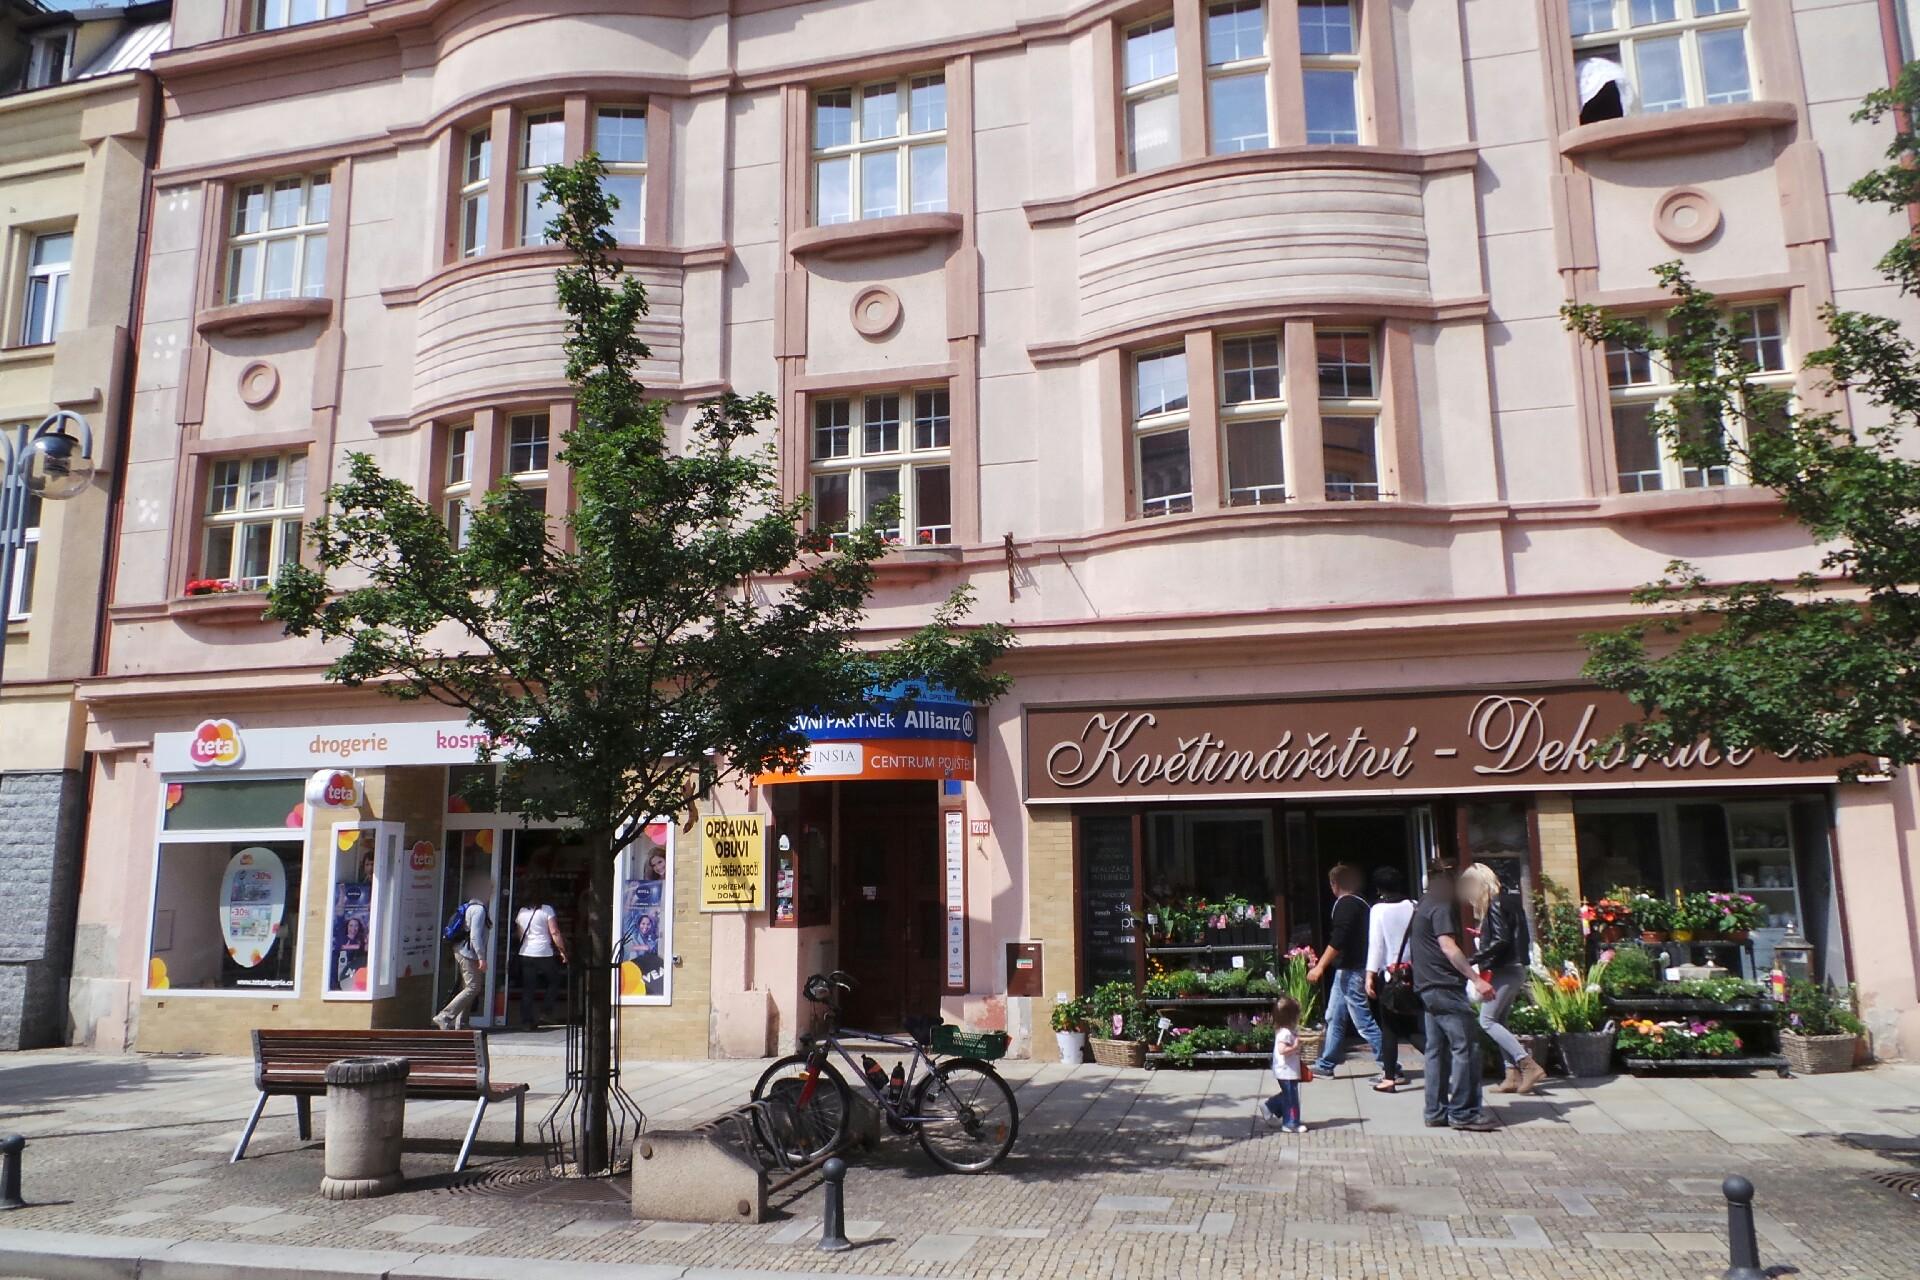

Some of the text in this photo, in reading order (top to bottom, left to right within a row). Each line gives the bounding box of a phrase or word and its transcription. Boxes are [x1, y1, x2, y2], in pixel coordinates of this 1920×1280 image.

[826, 712, 896, 729] PARTNER
[904, 710, 960, 731] Allianz
[195, 736, 234, 756] teta
[309, 732, 389, 757] drogerie
[1047, 712, 1418, 786] Květinářství
[871, 755, 935, 769] CENTRUM
[327, 784, 354, 800] teta
[705, 819, 759, 838] OPRAVNA
[715, 840, 749, 858] OBUVI
[705, 864, 710, 877] A
[711, 883, 717, 891] V
